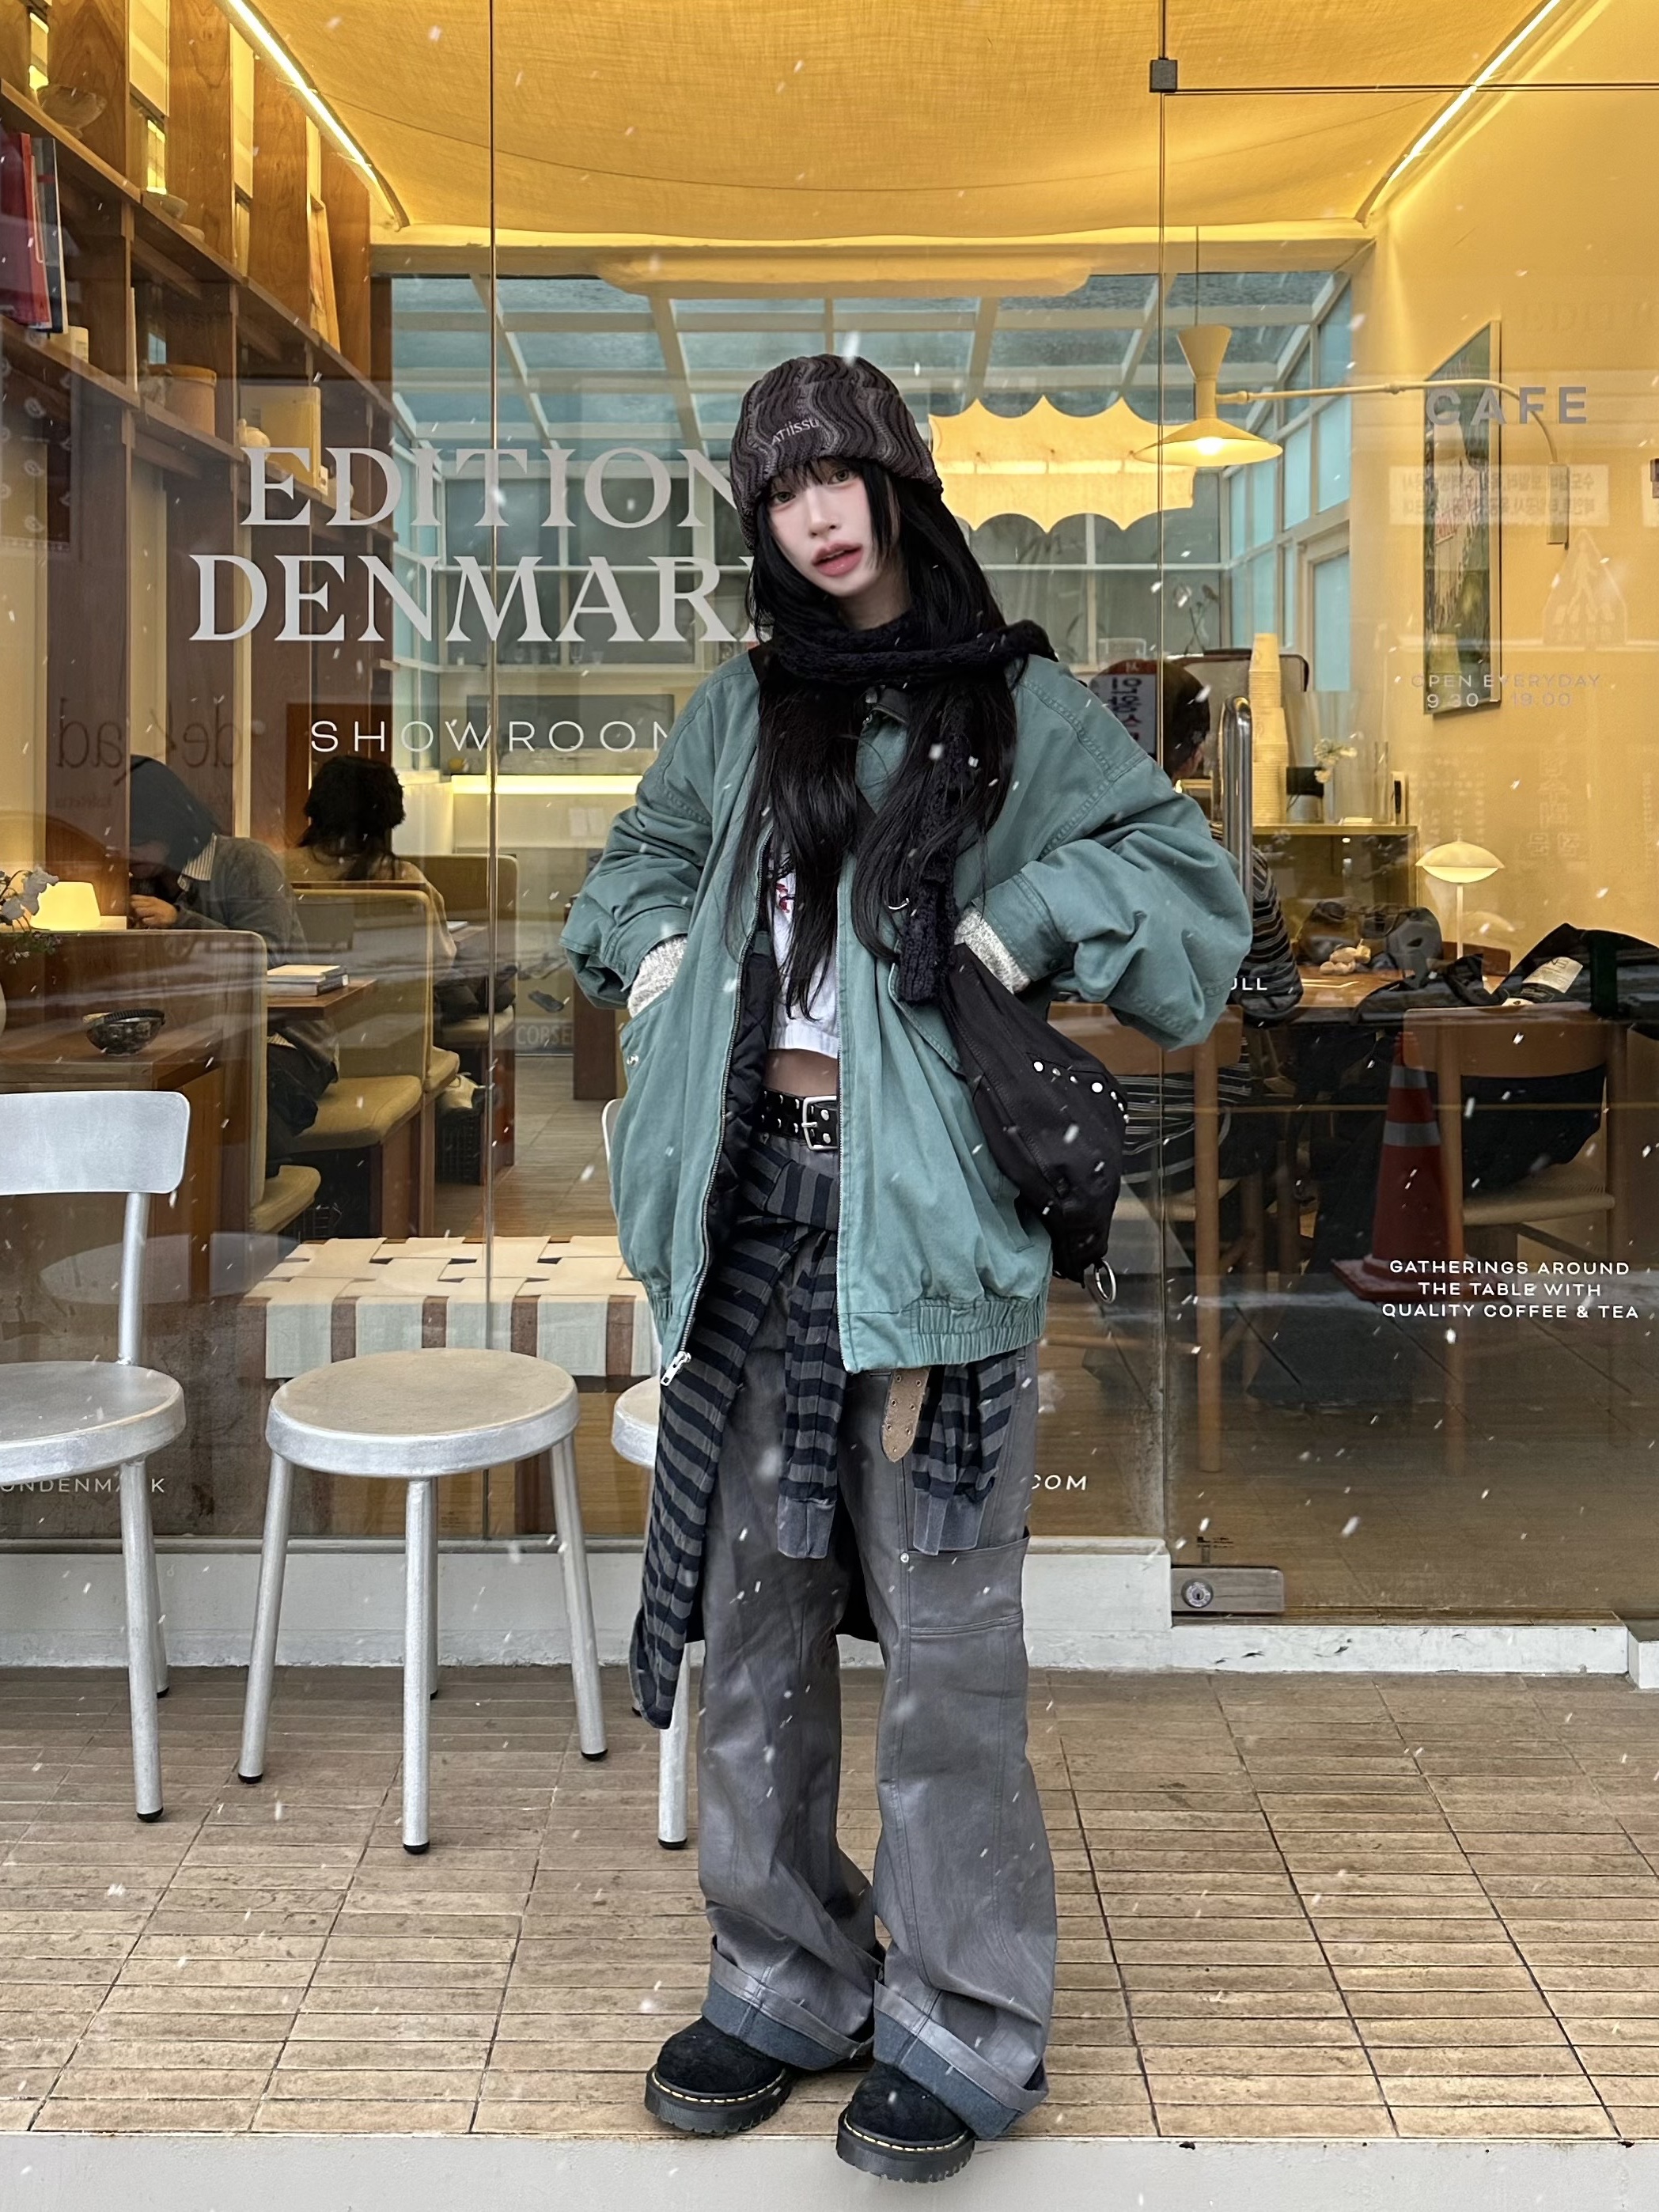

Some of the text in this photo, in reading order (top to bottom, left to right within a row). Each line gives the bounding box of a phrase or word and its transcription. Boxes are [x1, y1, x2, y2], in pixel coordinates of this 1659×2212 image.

[1425, 386, 1587, 425] CAFE
[240, 447, 737, 528] EDITION
[189, 555, 759, 642] DENMAR
[1411, 674, 1601, 688] OPEN EVERYDAY
[1389, 1259, 1630, 1275] GATHERINGS AROUND
[1418, 1282, 1601, 1297] THE TABLE WITH
[1382, 1304, 1639, 1319] QUALITY COFFEE & TEA
[0, 1478, 165, 1493] ONDENMK
